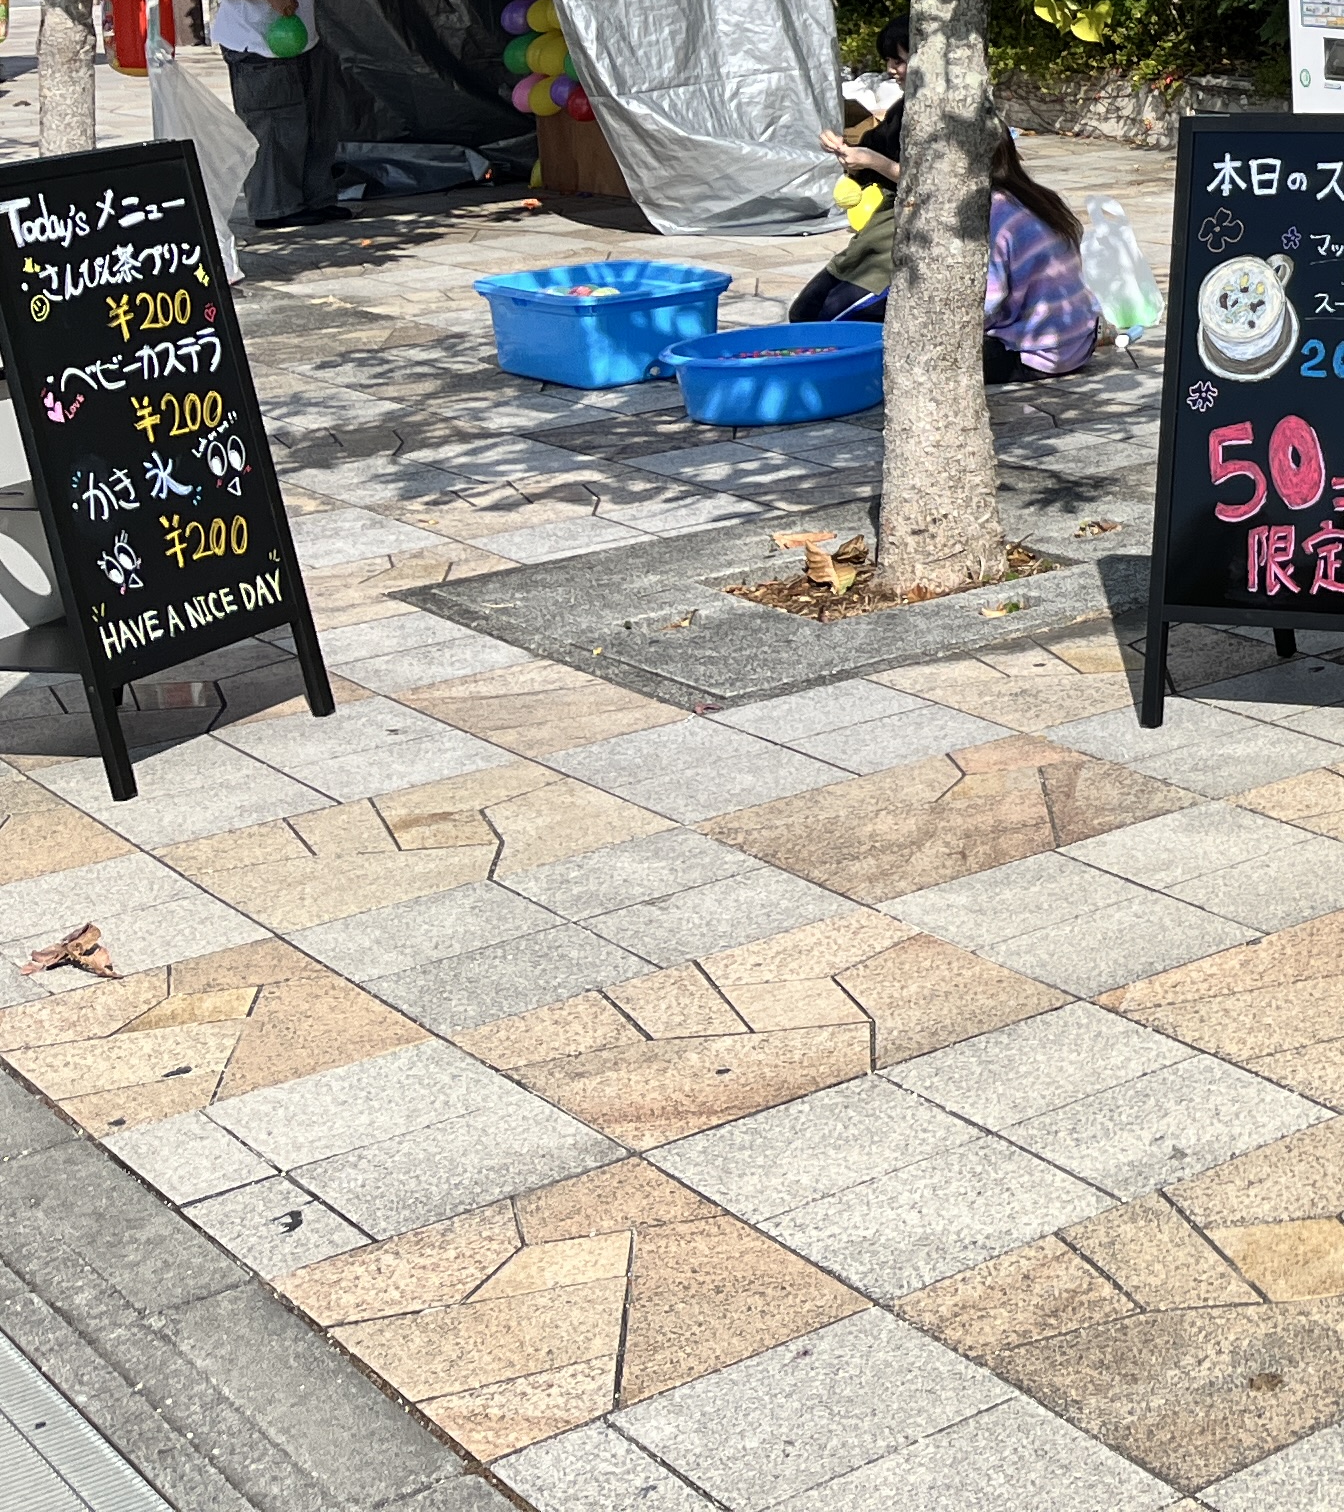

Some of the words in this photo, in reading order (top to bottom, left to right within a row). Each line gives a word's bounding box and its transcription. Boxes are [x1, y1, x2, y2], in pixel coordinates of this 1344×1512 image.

[0, 192, 91, 248] Today's
[96, 188, 186, 231] メニュー
[99, 609, 164, 660] HAVE
[167, 604, 185, 638] A
[183, 587, 238, 629] NICE
[238, 567, 283, 611] DAY
